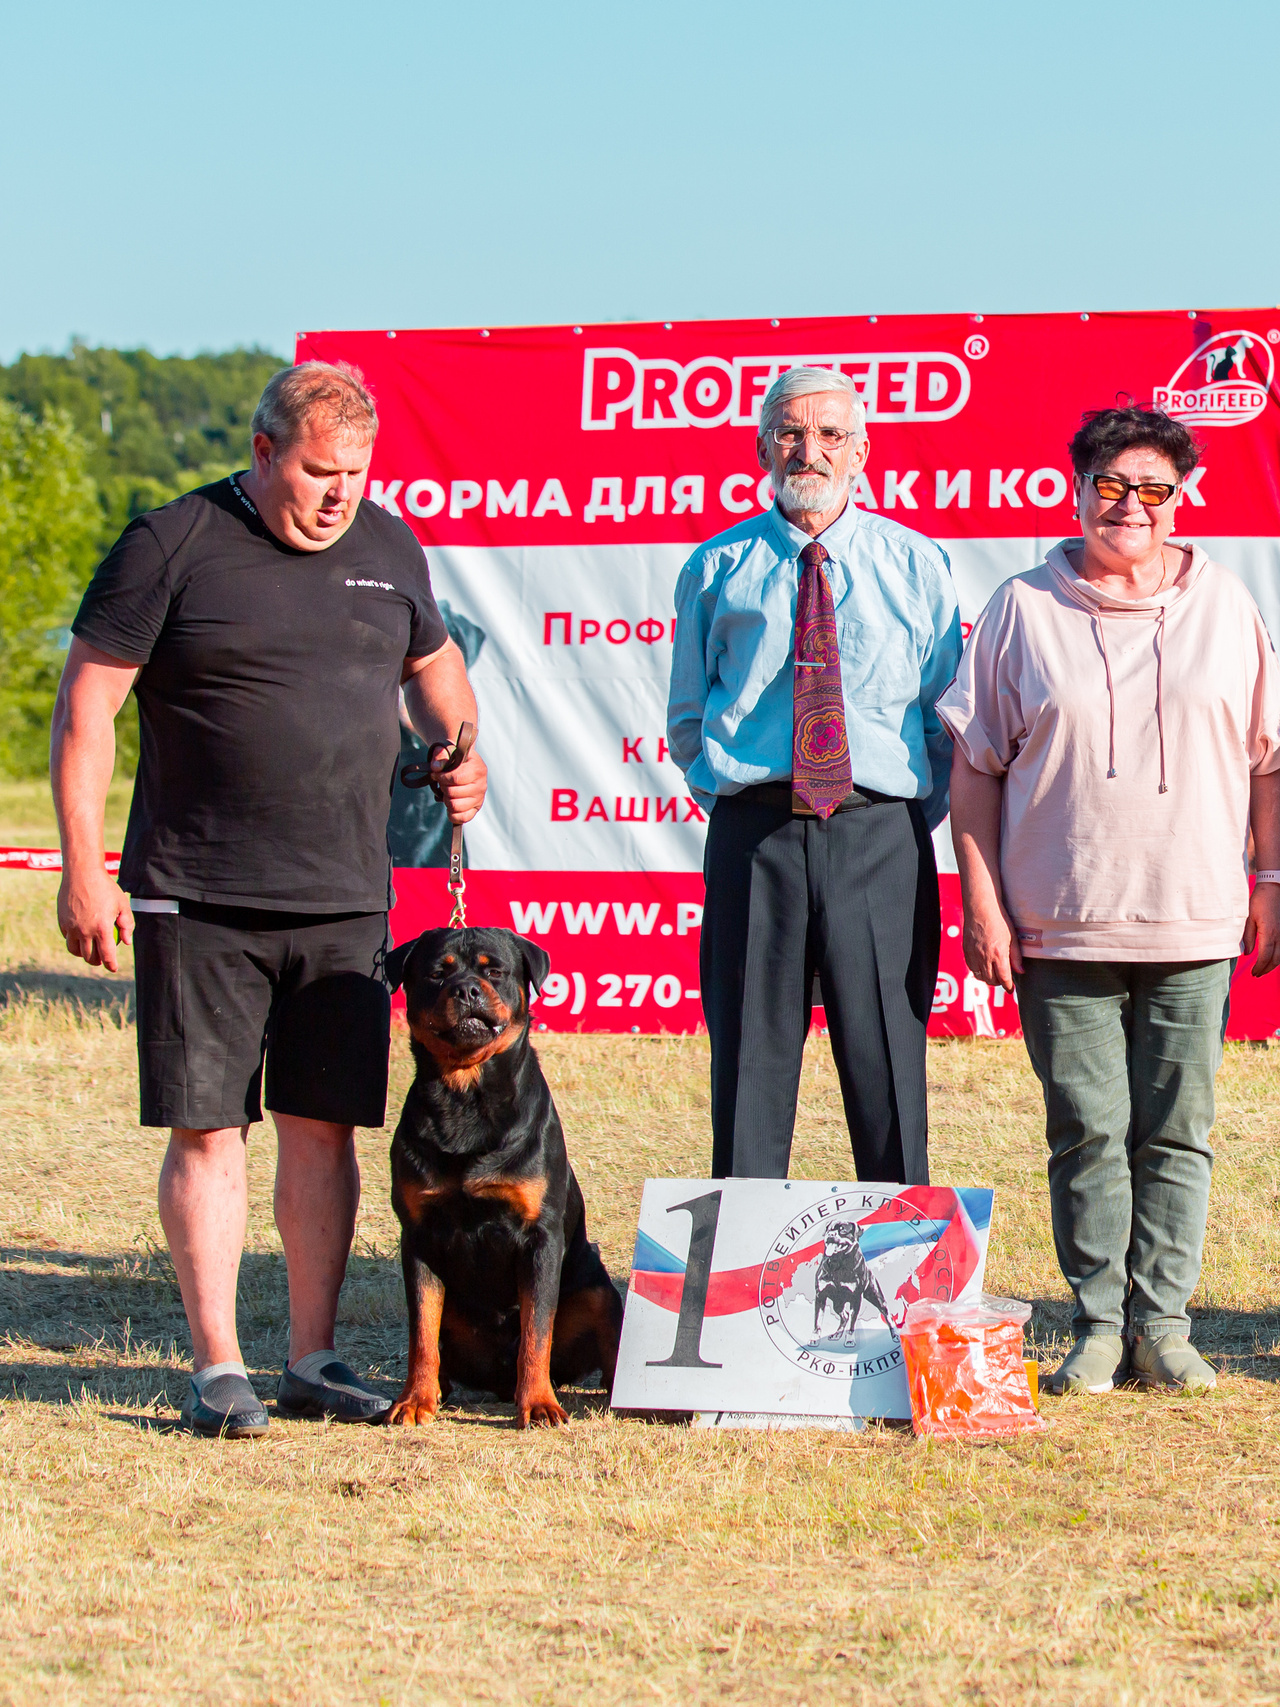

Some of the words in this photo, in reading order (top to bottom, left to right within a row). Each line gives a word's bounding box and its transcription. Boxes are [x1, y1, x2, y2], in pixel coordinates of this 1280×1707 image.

[581, 347, 971, 431] PROFEED
[1153, 386, 1267, 413] PROFIFEED
[369, 477, 573, 519] КОРМА
[583, 474, 705, 523] ДЛЯ
[719, 469, 921, 514] СОАК
[934, 468, 972, 509] И
[988, 466, 1207, 509] КОК
[344, 578, 356, 587] do
[530, 971, 587, 1015] 9)
[596, 972, 701, 1009] 270-
[645, 1189, 723, 1369] 1
[762, 1197, 847, 1327] РОТВЕЙЛЕР
[861, 1194, 924, 1227] КЛУБ
[925, 1231, 951, 1298] РОСС
[796, 1349, 901, 1377] РКФ-НКПР
